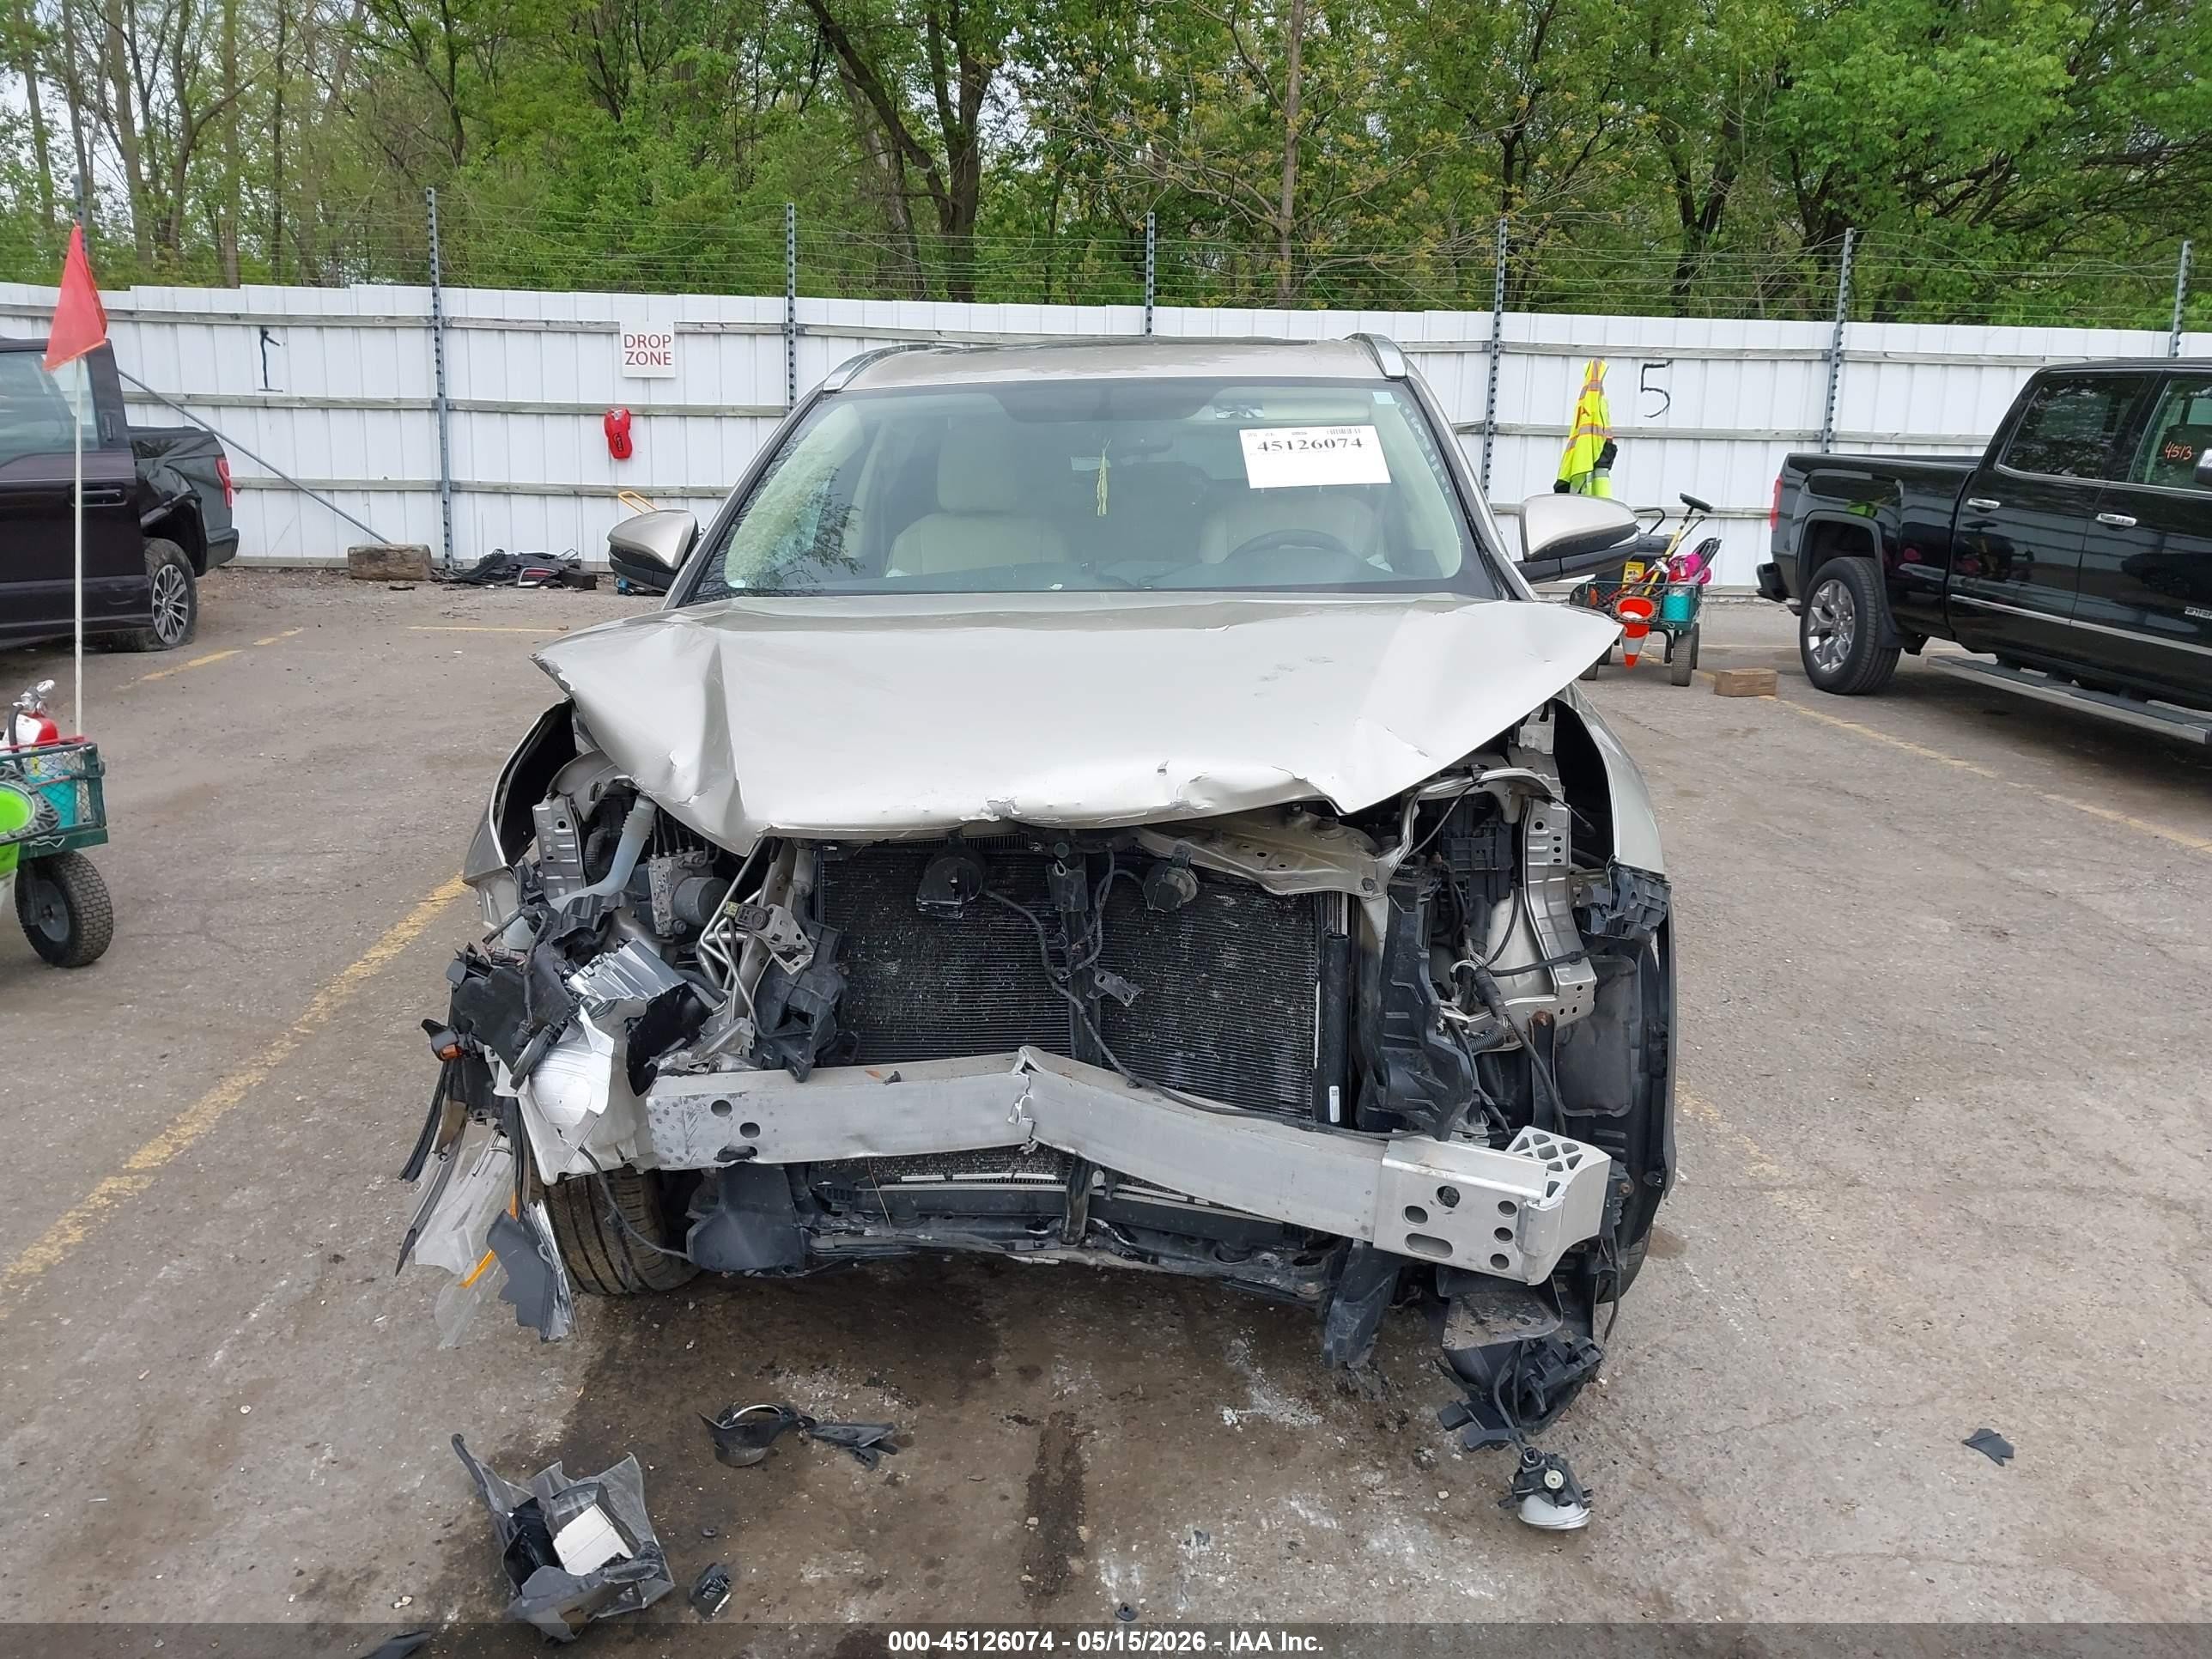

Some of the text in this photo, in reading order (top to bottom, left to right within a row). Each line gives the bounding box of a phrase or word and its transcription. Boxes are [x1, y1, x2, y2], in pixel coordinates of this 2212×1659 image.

[624, 334, 672, 349] DROP
[625, 351, 672, 366] ZONE
[1640, 359, 1673, 419] 5
[1257, 437, 1363, 452] 45126074
